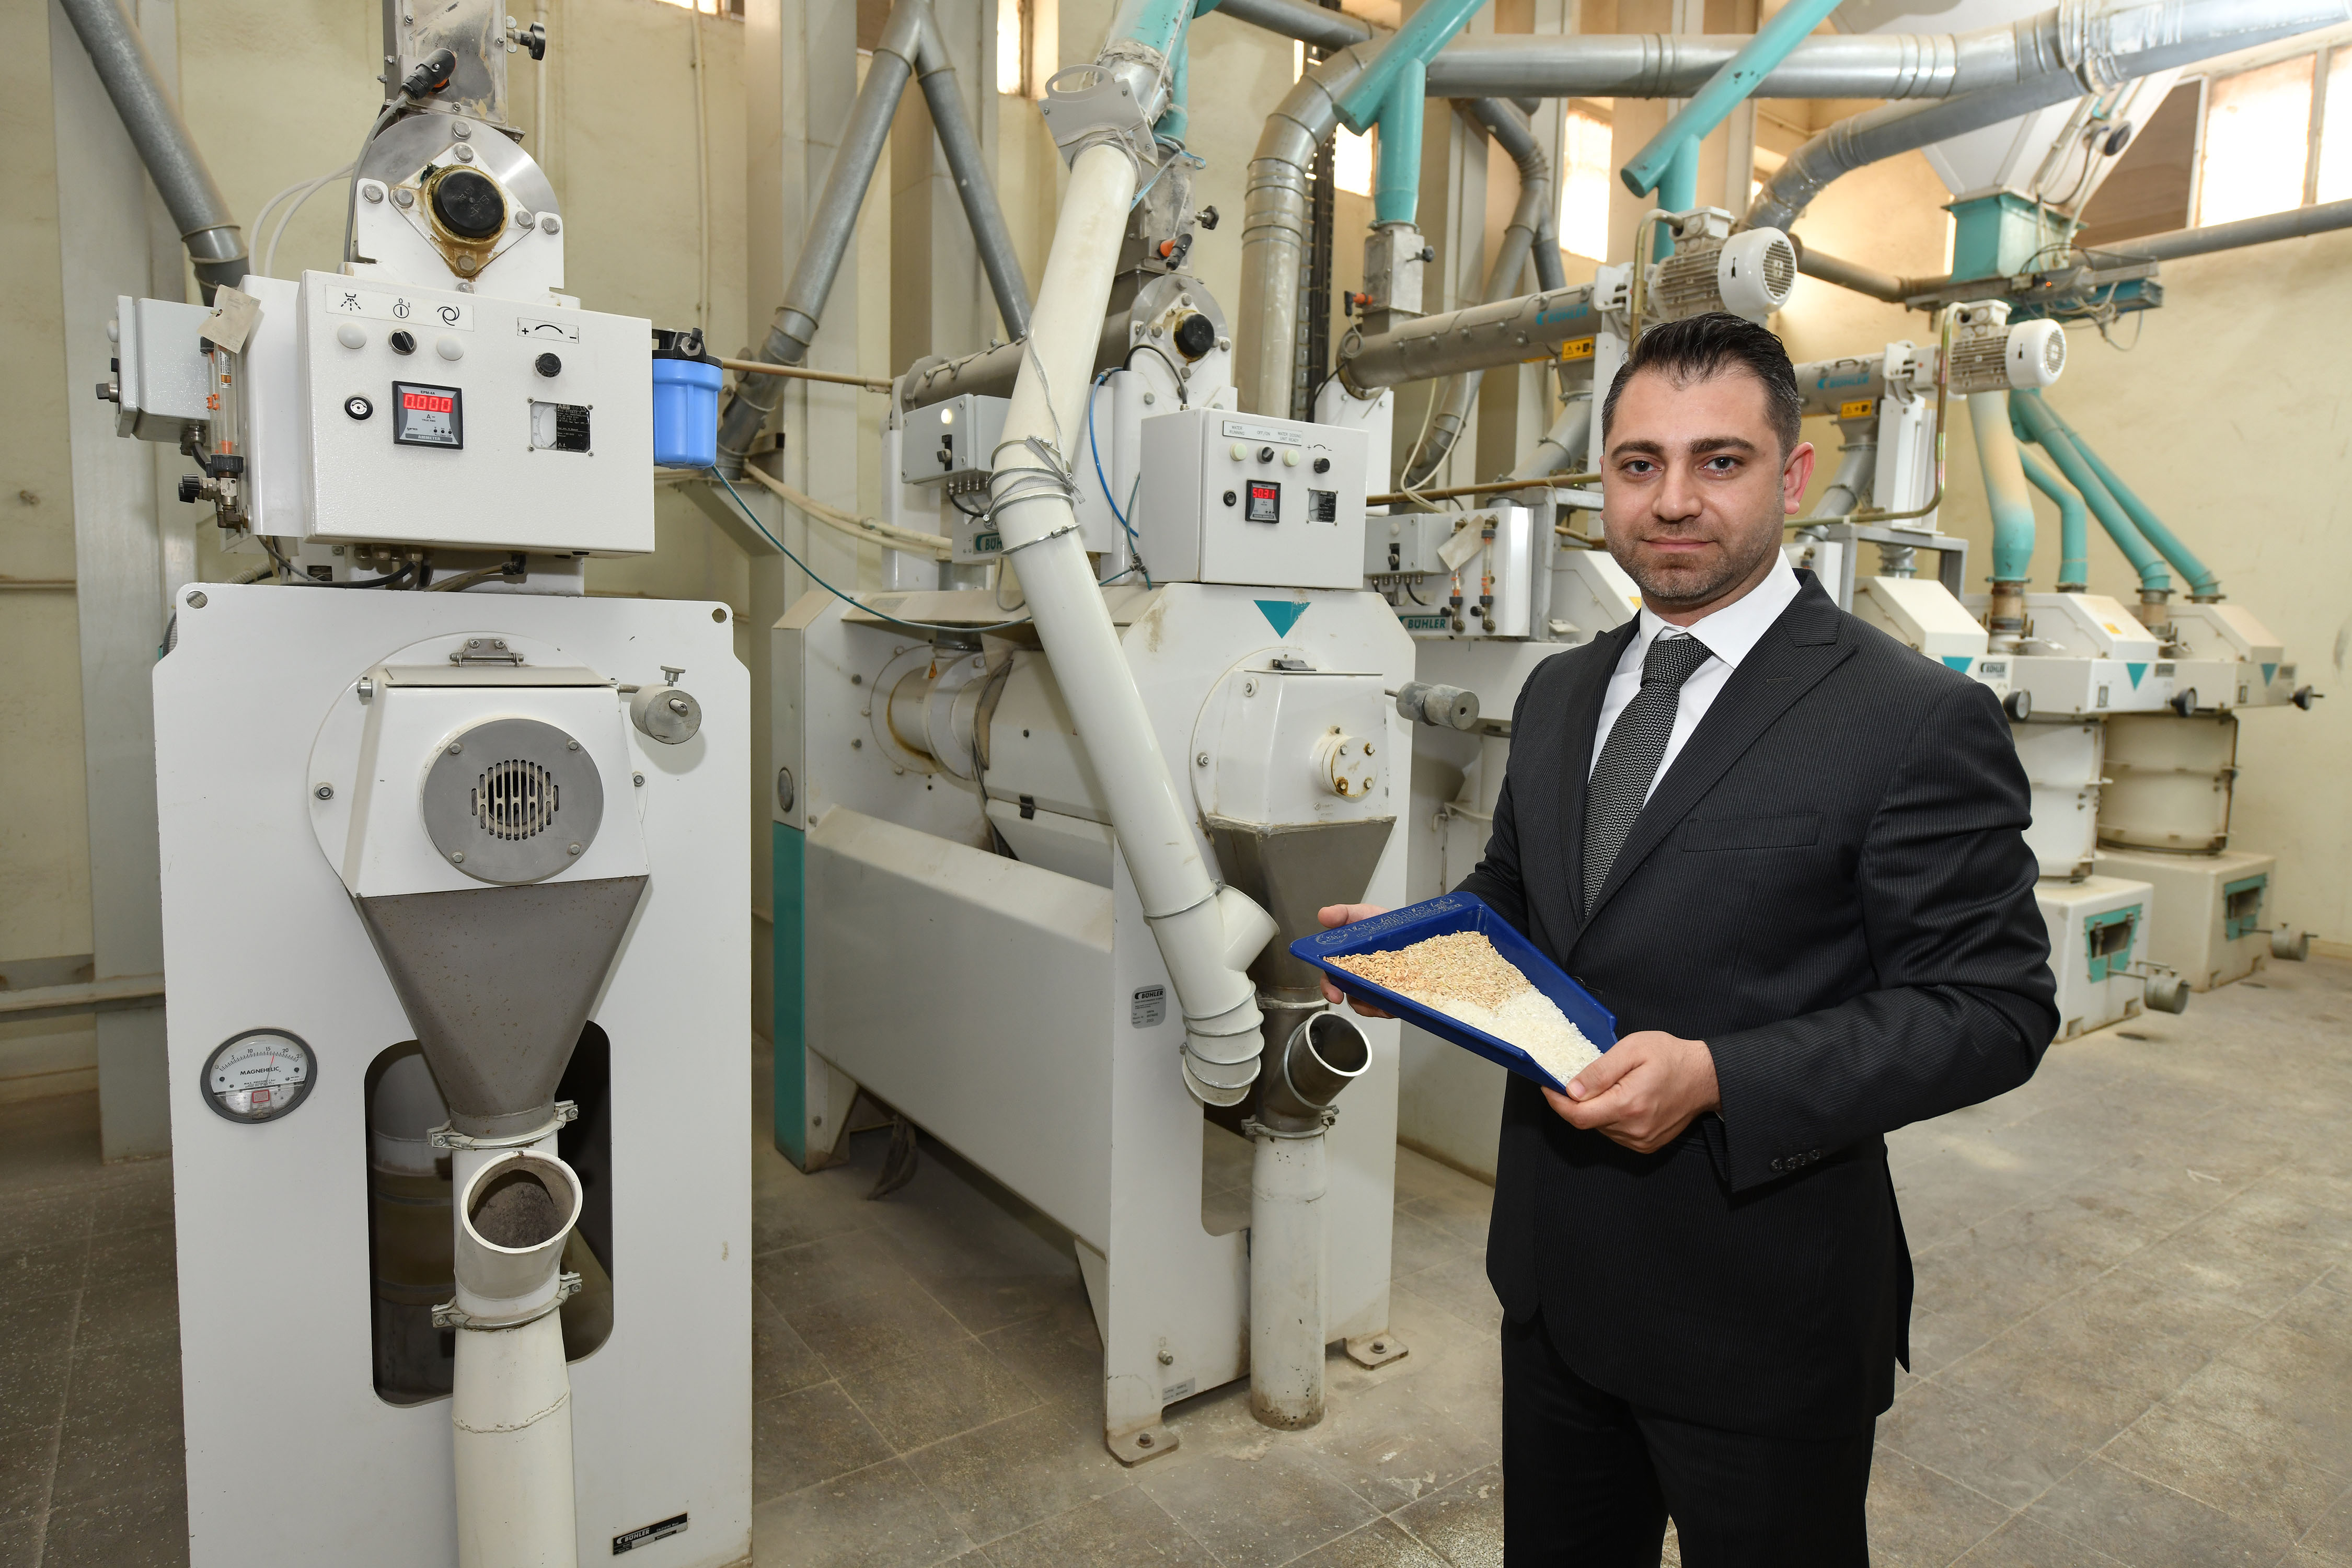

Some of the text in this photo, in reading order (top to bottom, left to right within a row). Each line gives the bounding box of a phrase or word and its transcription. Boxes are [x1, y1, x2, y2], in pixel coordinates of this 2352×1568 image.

[403, 394, 452, 412] 0.000
[1408, 618, 1446, 629] BÜHLER
[1142, 990, 1163, 999] BÜHLER
[240, 1066, 280, 1076] MAGNEHELIC
[624, 1529, 650, 1542] BÜHLER
